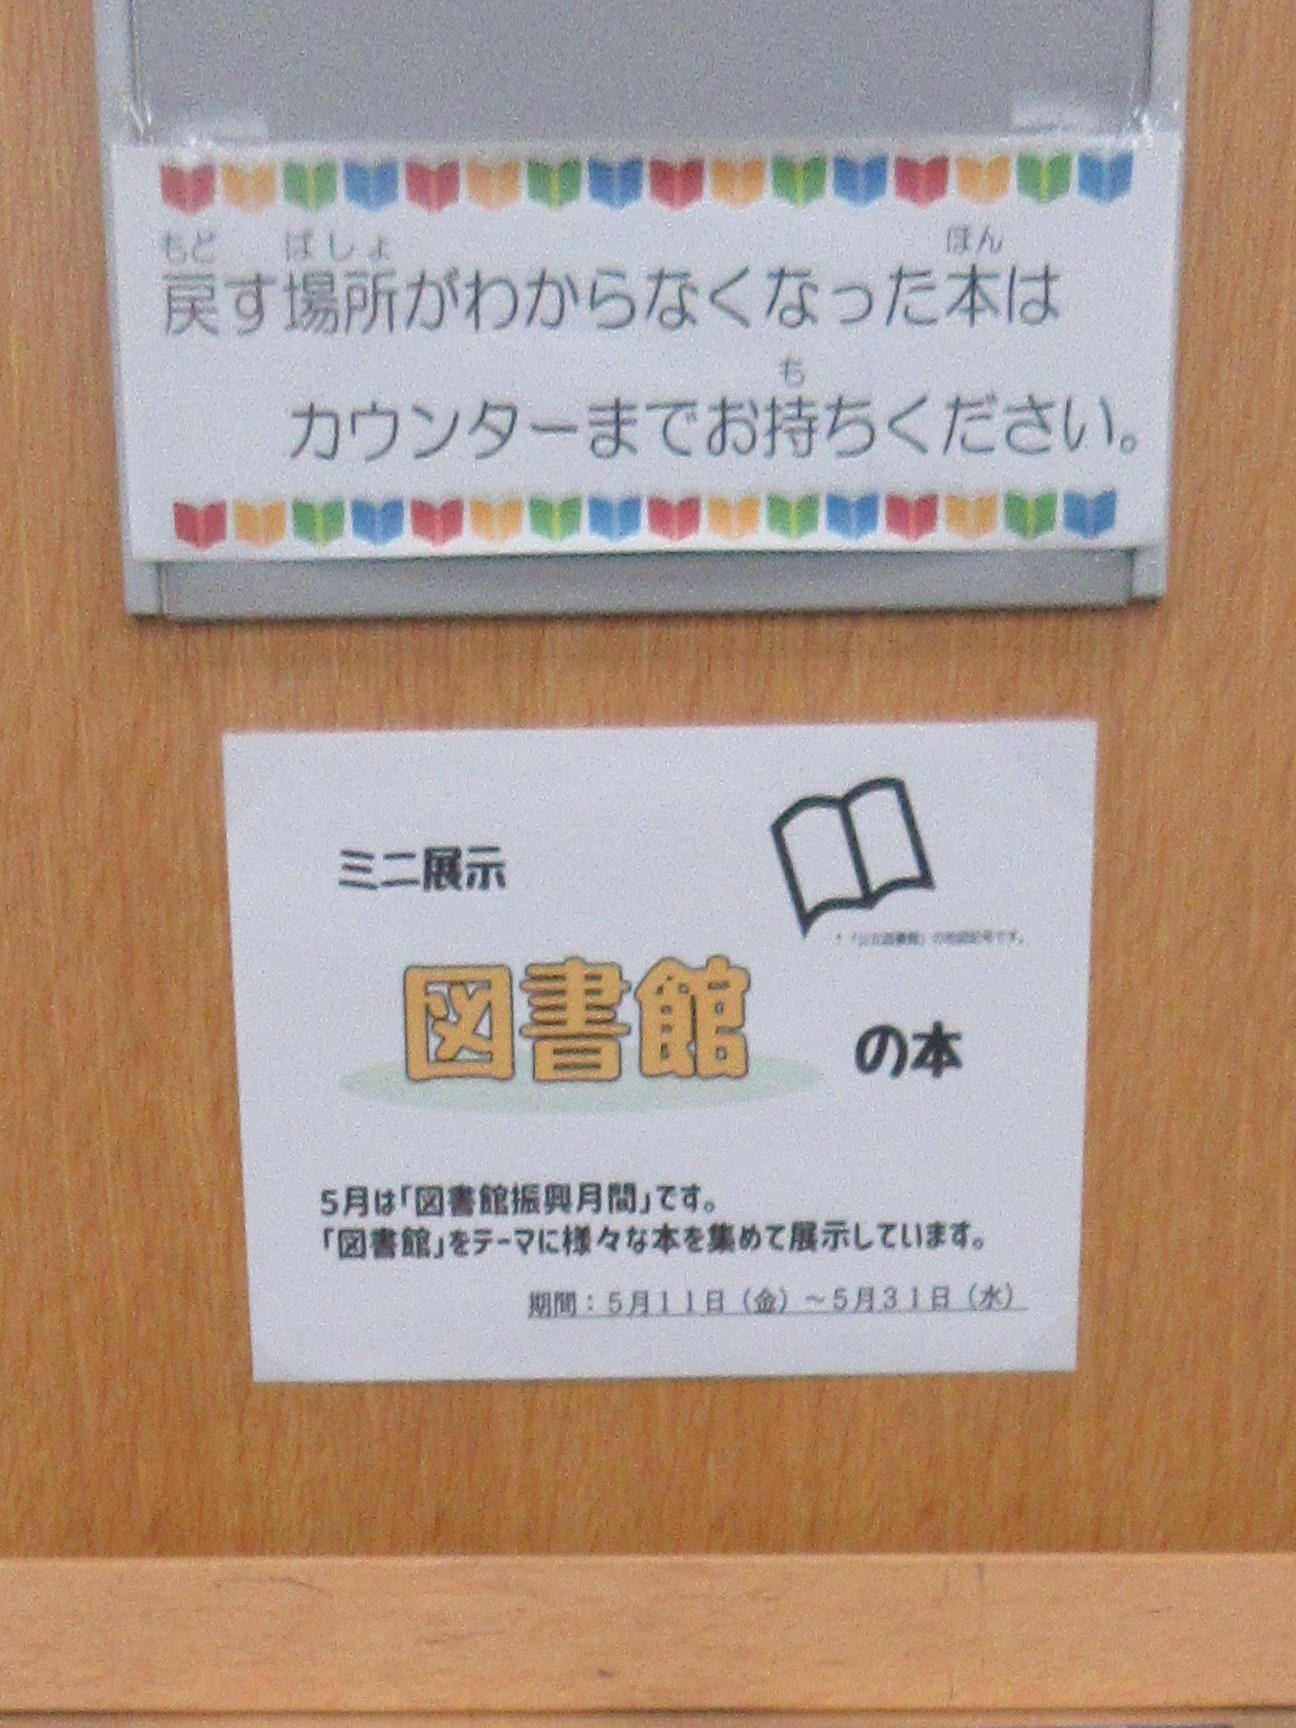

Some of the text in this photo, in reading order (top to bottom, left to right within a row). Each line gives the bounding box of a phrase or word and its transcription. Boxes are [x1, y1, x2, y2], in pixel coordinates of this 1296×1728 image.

[161, 230, 218, 264] もど
[285, 229, 393, 264] ばしょ
[946, 224, 1004, 256] ほん
[162, 265, 1061, 338] 戻す場所がわからなくなった本は
[779, 354, 807, 388] も
[289, 395, 1141, 462] カウンターまでお持ちください。
[337, 845, 507, 894] ミニ展示
[401, 952, 963, 1084] 図書館 の本
[319, 1182, 717, 1219] 5月は「図書館振興月間」です。
[321, 1219, 990, 1262] 「図書館」をテーマに様々な本を集めて展示しています。
